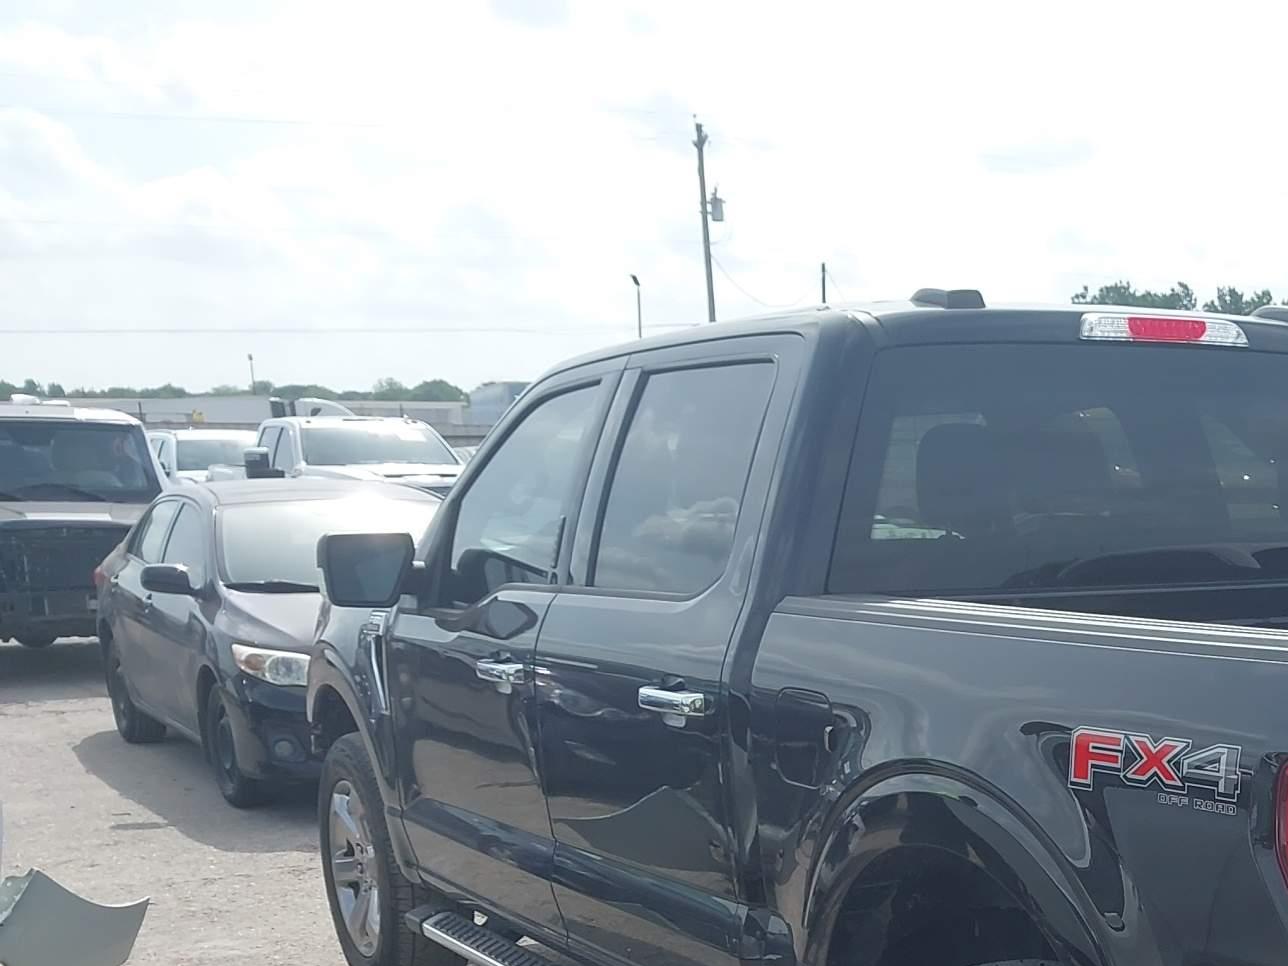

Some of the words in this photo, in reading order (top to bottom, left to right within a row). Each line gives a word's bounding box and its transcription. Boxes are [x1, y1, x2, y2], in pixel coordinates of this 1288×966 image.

[1069, 726, 1242, 802] FX4
[1157, 792, 1189, 807] OFF
[1193, 798, 1237, 816] ROAD
